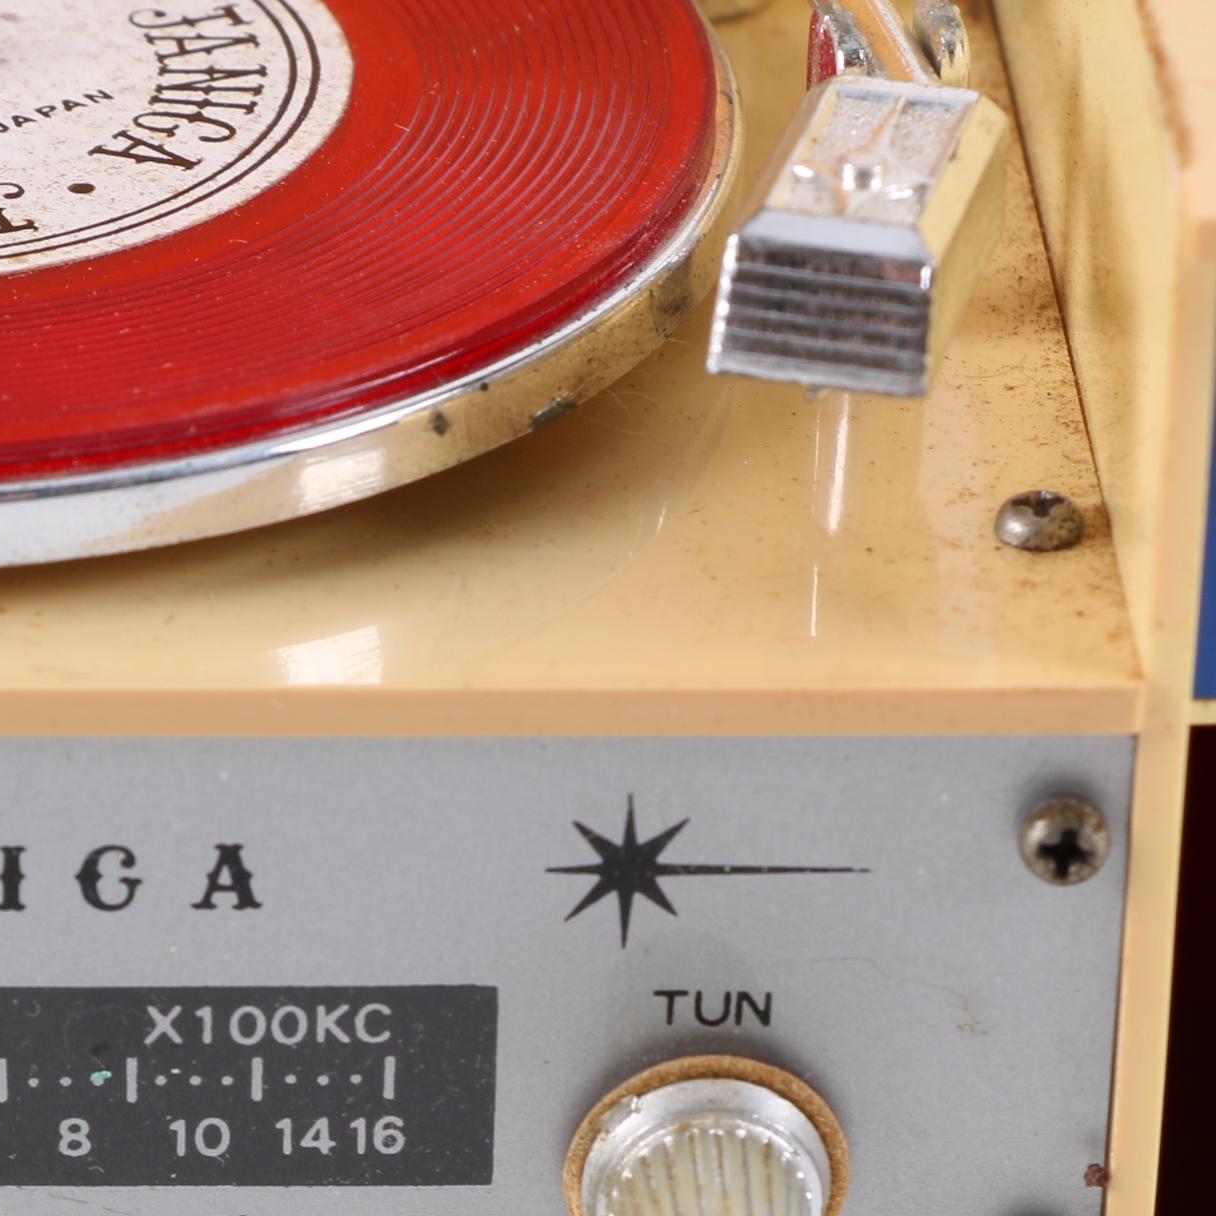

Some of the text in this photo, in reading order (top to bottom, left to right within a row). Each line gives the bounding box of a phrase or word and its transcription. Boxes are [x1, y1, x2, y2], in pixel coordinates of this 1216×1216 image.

[87, 4, 268, 171] JANIGA
[144, 1003, 394, 1045] X100KC
[653, 990, 772, 1027] TUN
[58, 1118, 92, 1156] 8
[170, 1118, 231, 1157] 10
[275, 1117, 336, 1155] 14
[349, 1116, 406, 1154] 16
